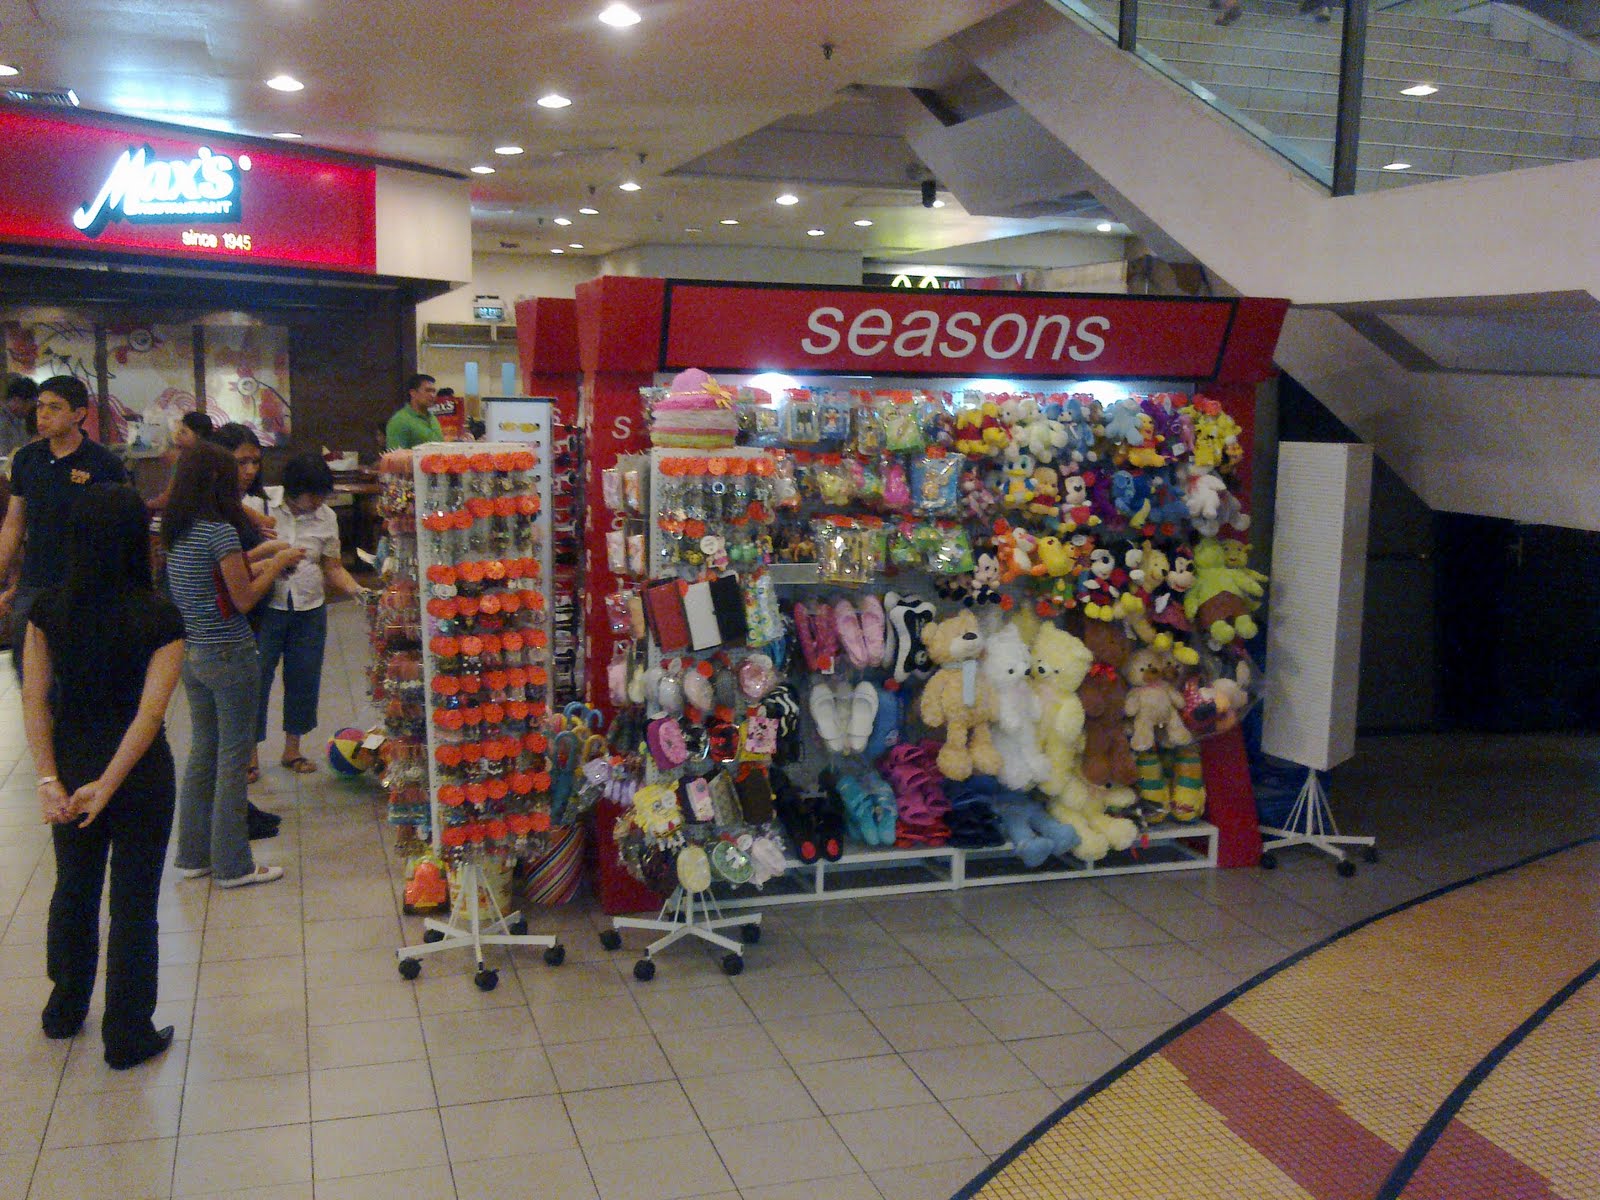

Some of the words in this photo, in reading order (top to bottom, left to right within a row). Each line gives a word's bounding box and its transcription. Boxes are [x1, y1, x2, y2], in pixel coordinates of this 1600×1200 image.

[73, 147, 234, 230] Max's
[181, 229, 218, 248] since
[222, 233, 252, 251] 1945
[801, 305, 1111, 363] seasons
